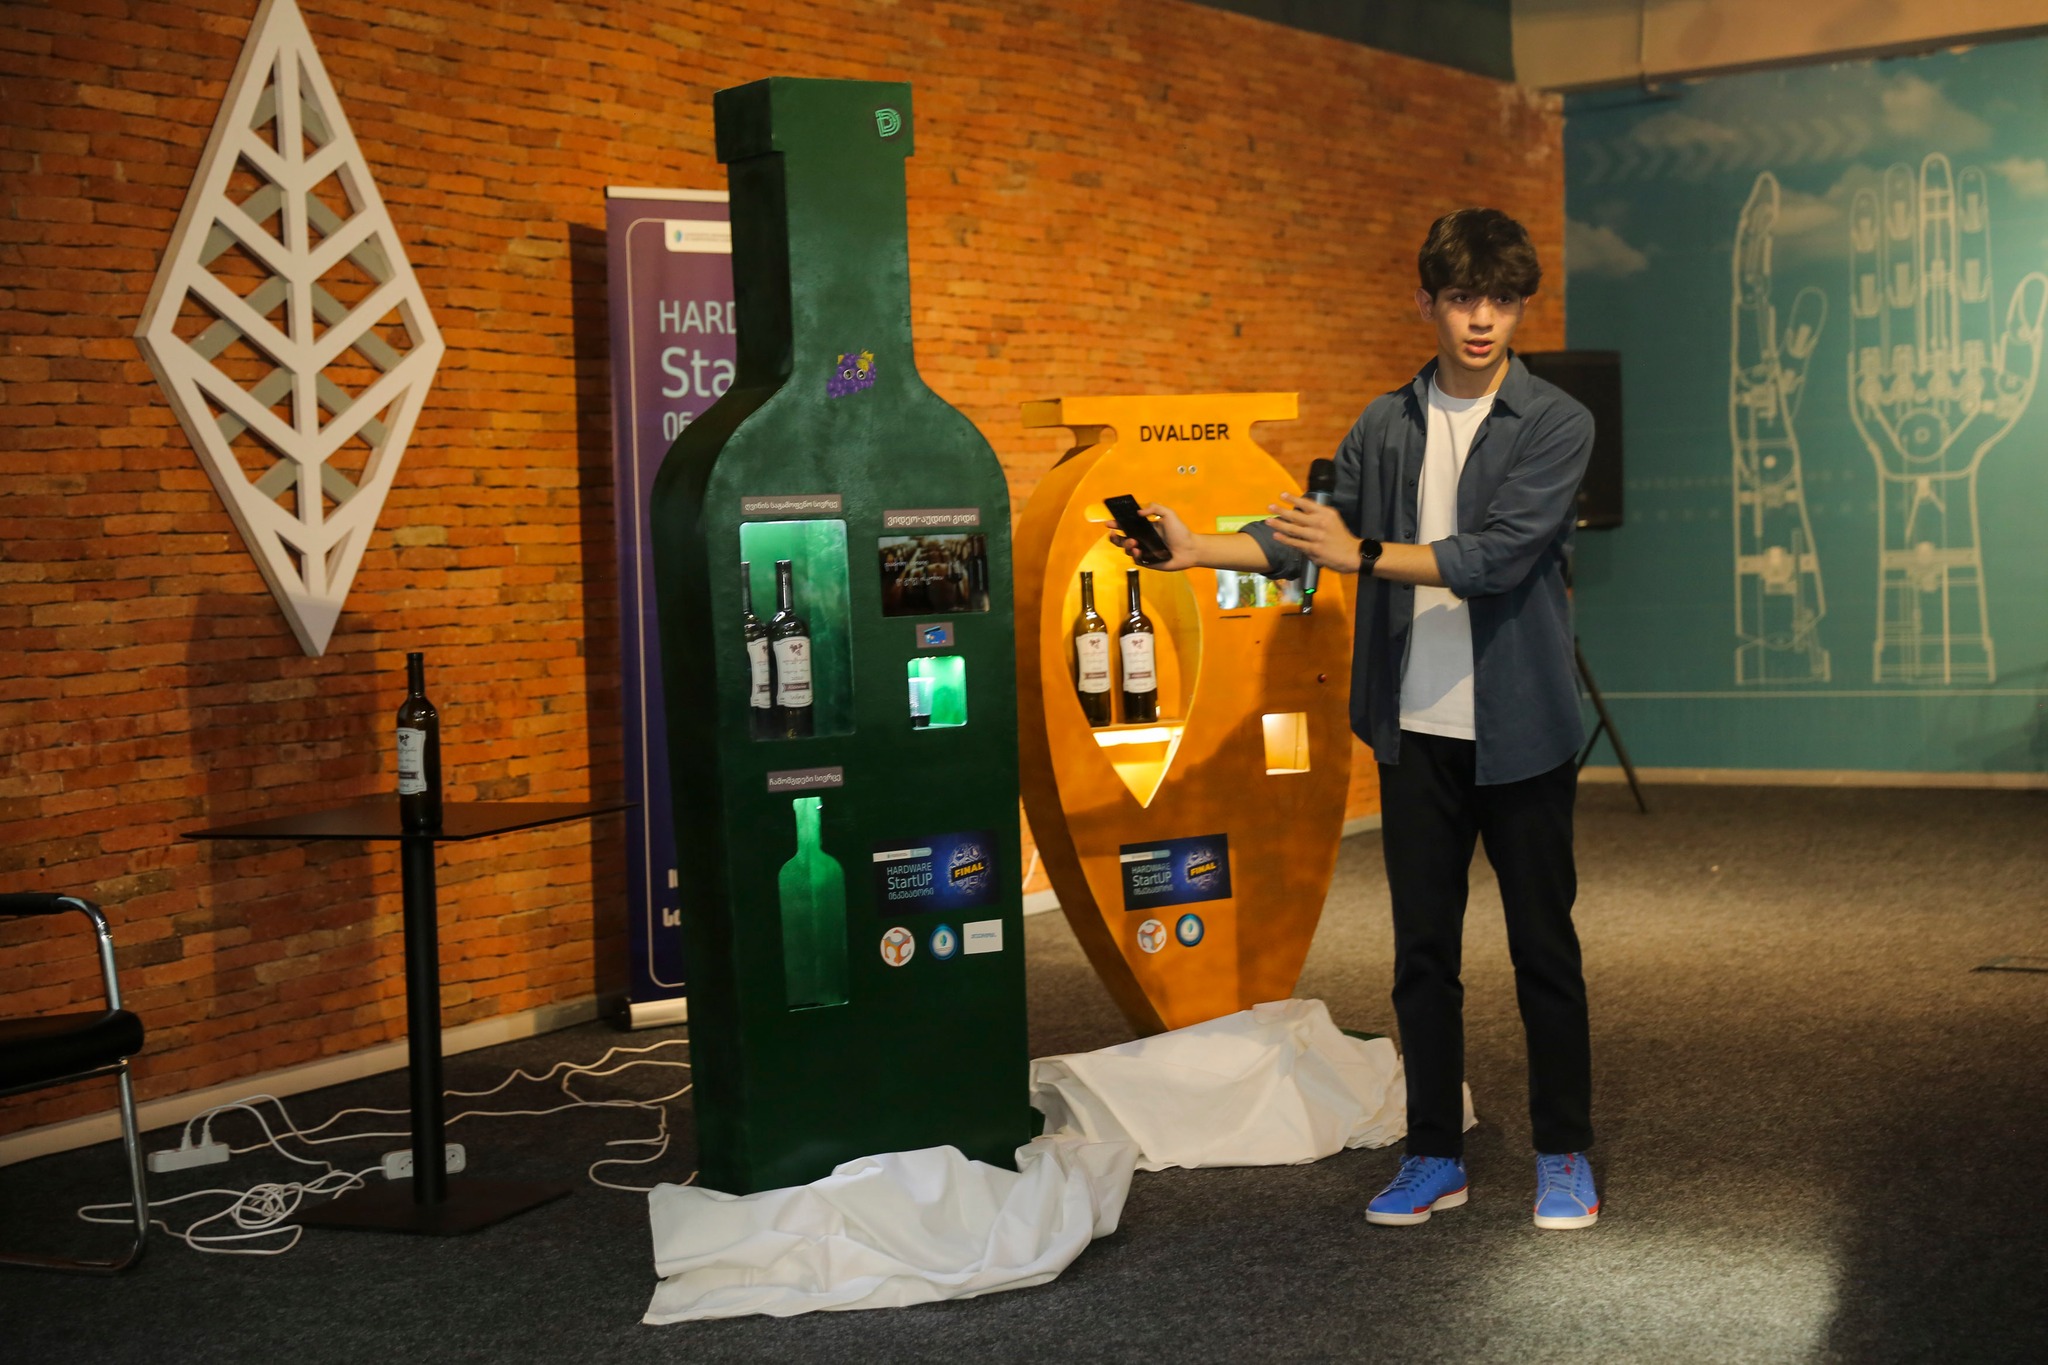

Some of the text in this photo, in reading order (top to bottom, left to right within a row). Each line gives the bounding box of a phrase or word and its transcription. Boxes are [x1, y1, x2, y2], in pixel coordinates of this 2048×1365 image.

[1140, 423, 1230, 442] DVALDER
[887, 862, 932, 876] HARDWARE
[954, 862, 985, 878] FINAL
[1131, 862, 1171, 874] HARDWARE
[1190, 862, 1217, 877] FINAL
[887, 872, 933, 890] StartUP
[1132, 871, 1172, 887] StartUP
